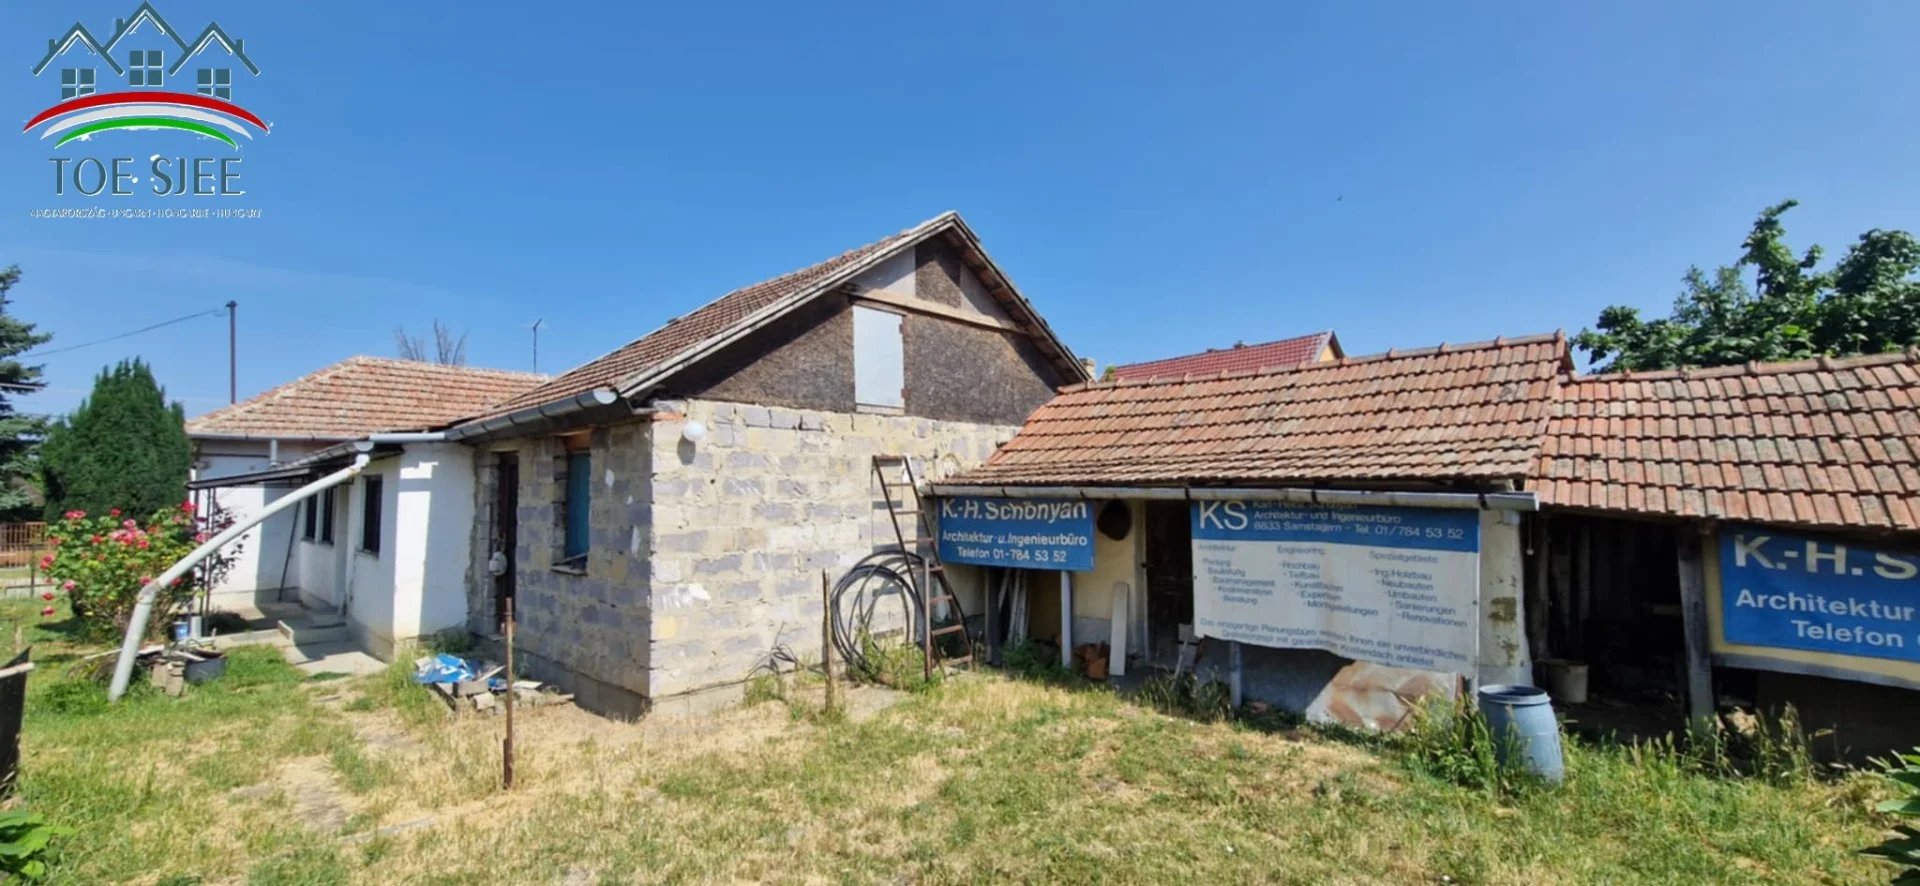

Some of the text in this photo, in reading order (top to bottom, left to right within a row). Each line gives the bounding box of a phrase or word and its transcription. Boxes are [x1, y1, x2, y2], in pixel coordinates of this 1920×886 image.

[1200, 500, 1249, 530] KS
[1425, 527, 1442, 539] 53
[1447, 528, 1464, 540] 52
[957, 546, 1068, 563] Telefon 01-784 53 52
[1735, 534, 1863, 576] K.-H.
[1791, 619, 1904, 648] Telefon
